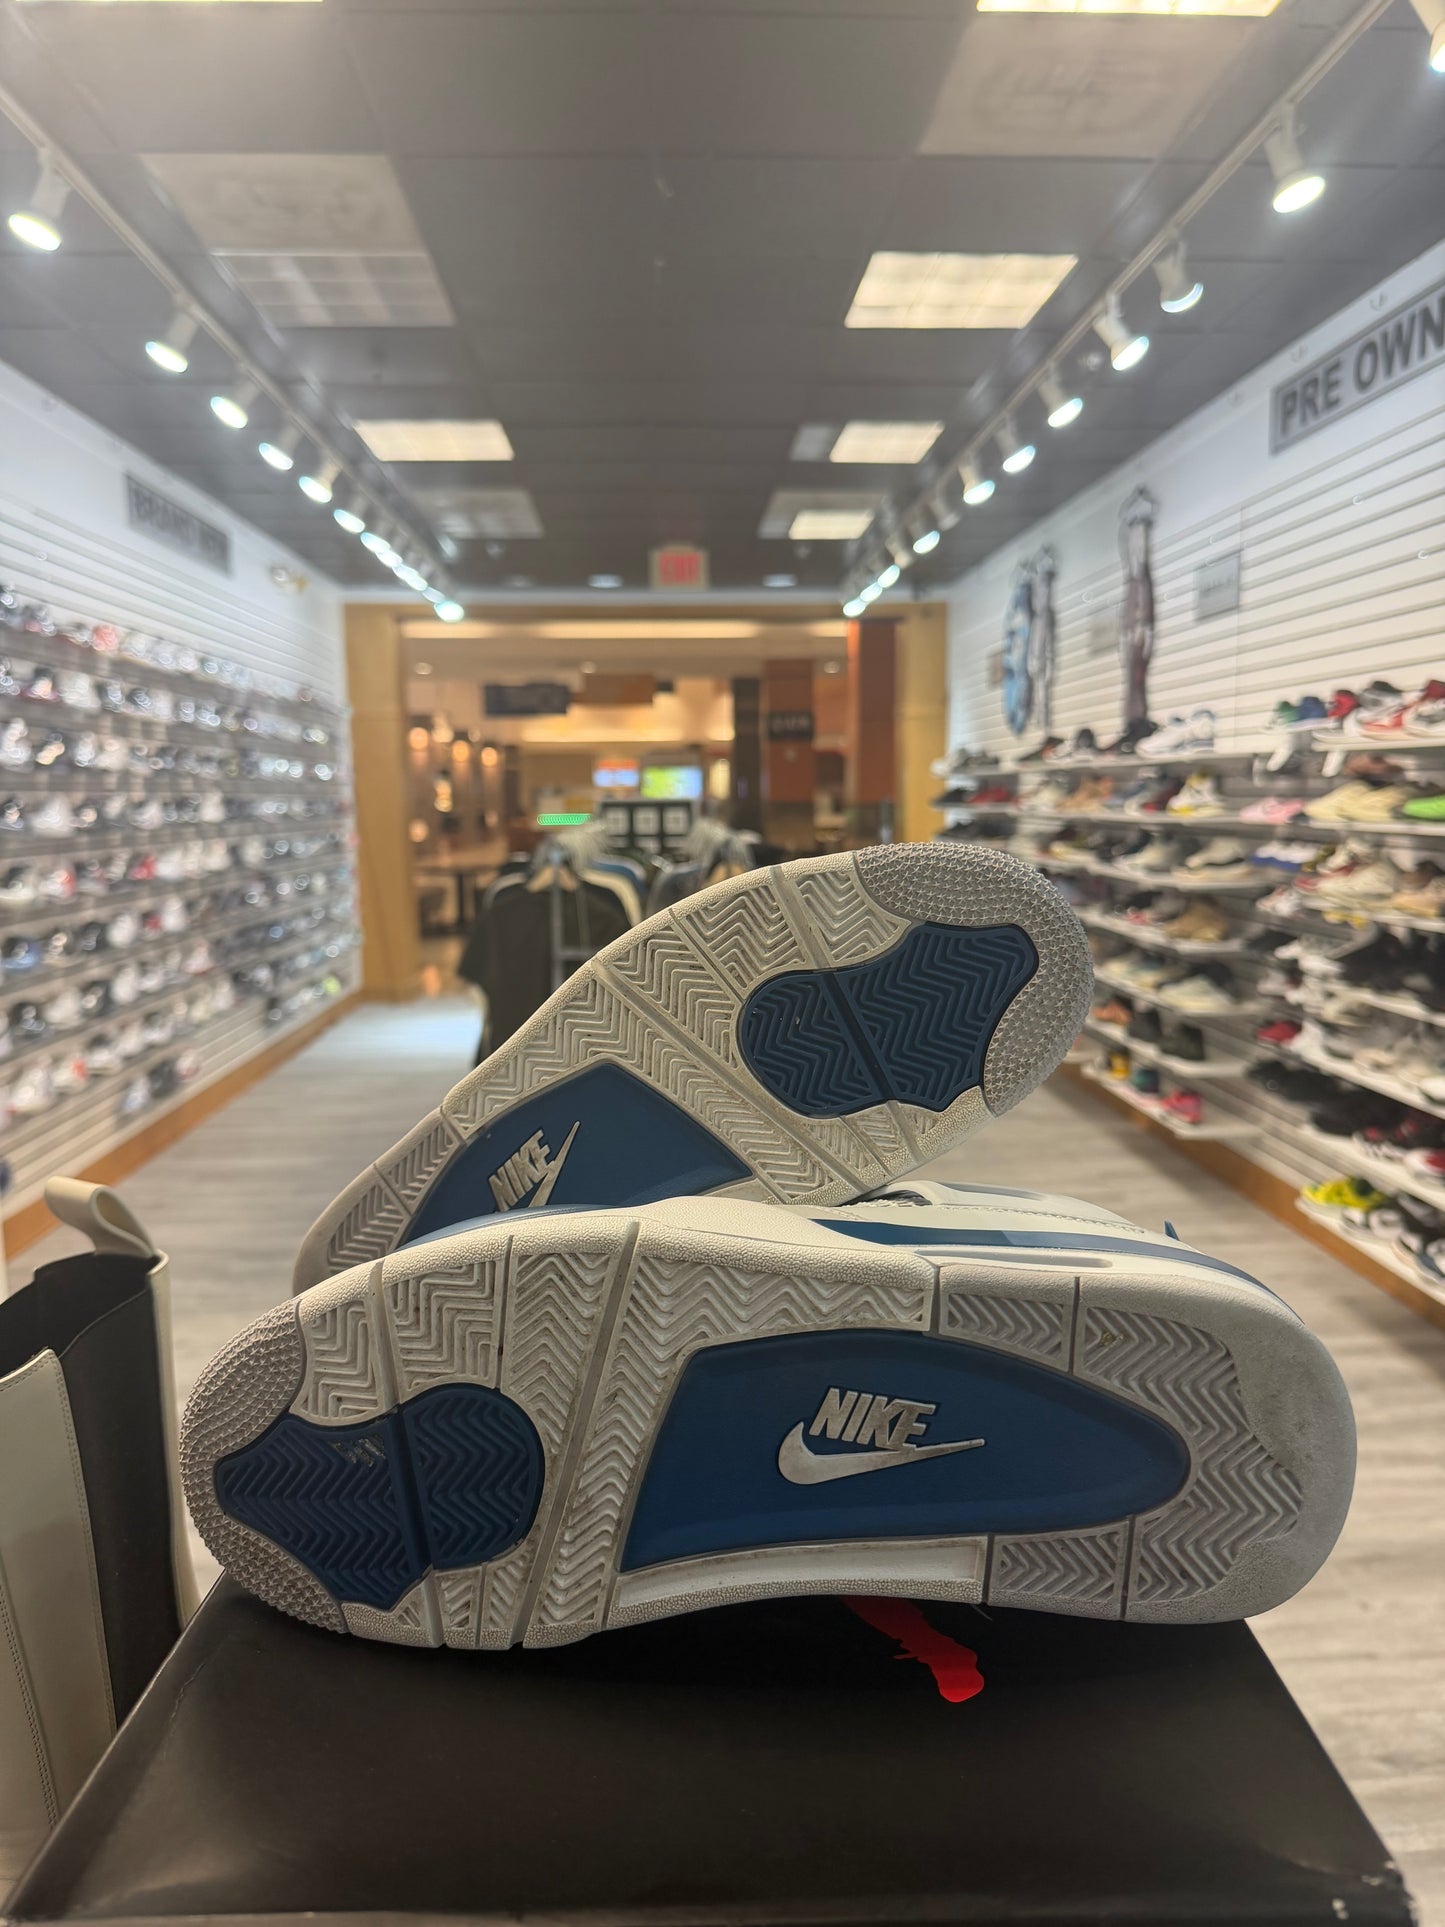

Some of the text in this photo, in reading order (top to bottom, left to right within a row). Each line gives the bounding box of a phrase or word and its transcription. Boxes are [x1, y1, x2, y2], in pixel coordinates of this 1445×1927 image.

[1280, 296, 1445, 437] PRE OWN
[488, 1129, 553, 1212] NIKE
[808, 1387, 936, 1451] NIKE
